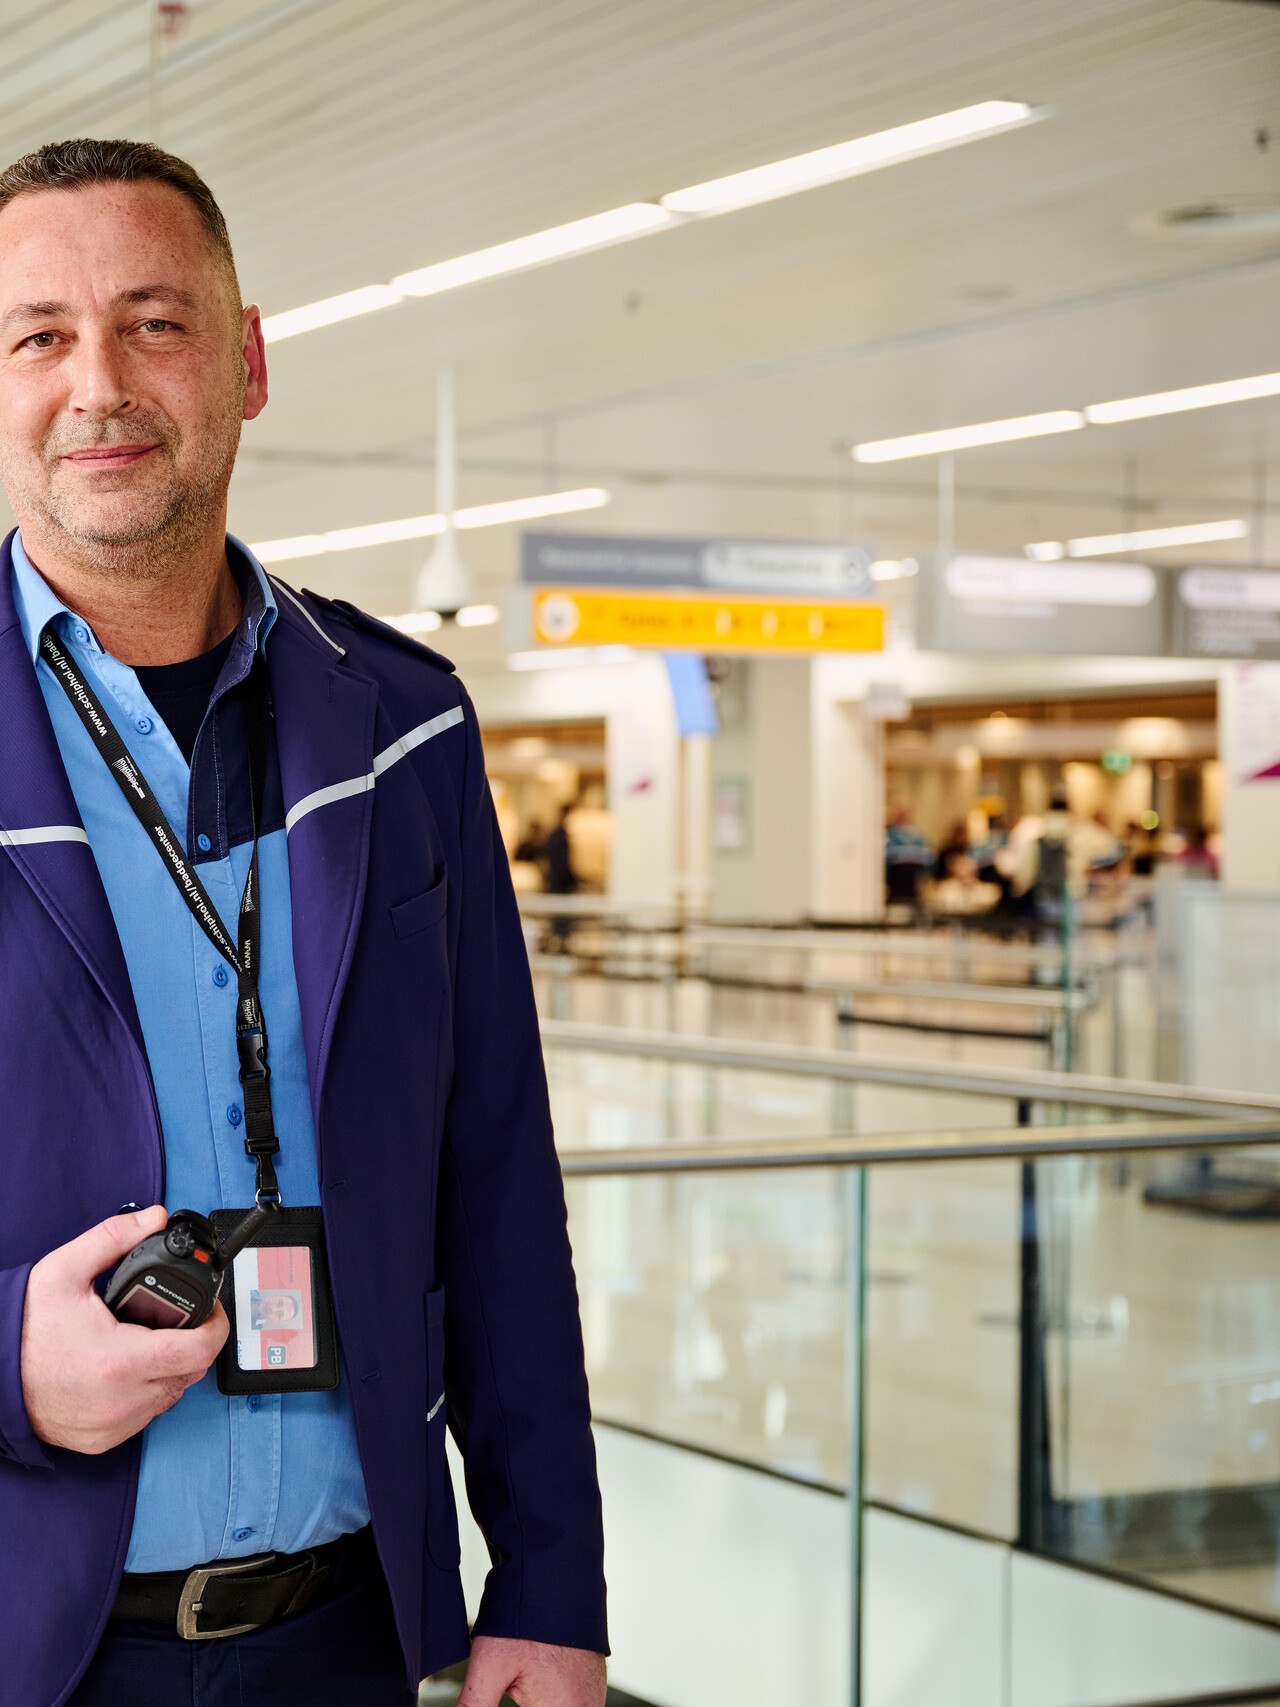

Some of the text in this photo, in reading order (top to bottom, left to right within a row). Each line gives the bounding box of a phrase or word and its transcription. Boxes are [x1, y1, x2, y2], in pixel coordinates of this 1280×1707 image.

[154, 825, 243, 973] www.schiphol.nl/badgecenter
[156, 1284, 196, 1308] MOTOROLA
[270, 1347, 282, 1364] PB
